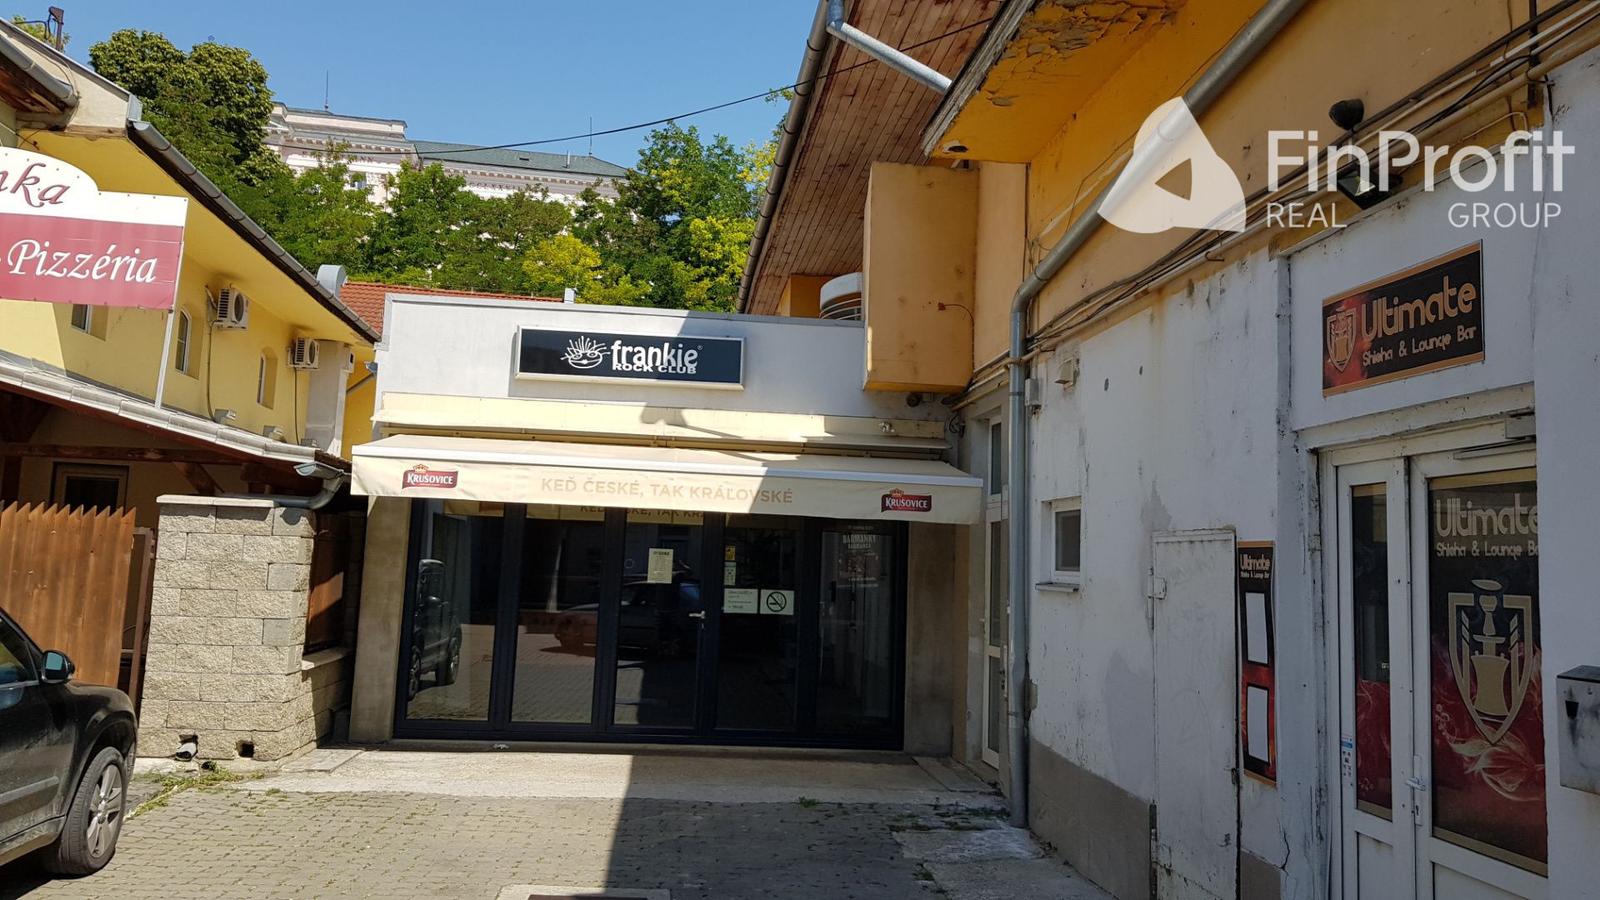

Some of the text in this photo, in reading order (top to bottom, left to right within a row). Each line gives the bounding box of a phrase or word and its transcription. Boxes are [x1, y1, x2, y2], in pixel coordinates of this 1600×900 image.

[7, 238, 158, 284] Pizzéria
[1361, 275, 1477, 342] Ultimate
[611, 339, 699, 369] frankie
[1398, 340, 1408, 358] &
[1412, 332, 1452, 353] Lounge
[1457, 325, 1477, 342] Bar
[613, 362, 697, 375] ROCK CLUB
[650, 483, 684, 498] TAK
[1435, 492, 1538, 537] Ultimate
[1471, 540, 1480, 556] &
[1484, 541, 1522, 560] Lounge
